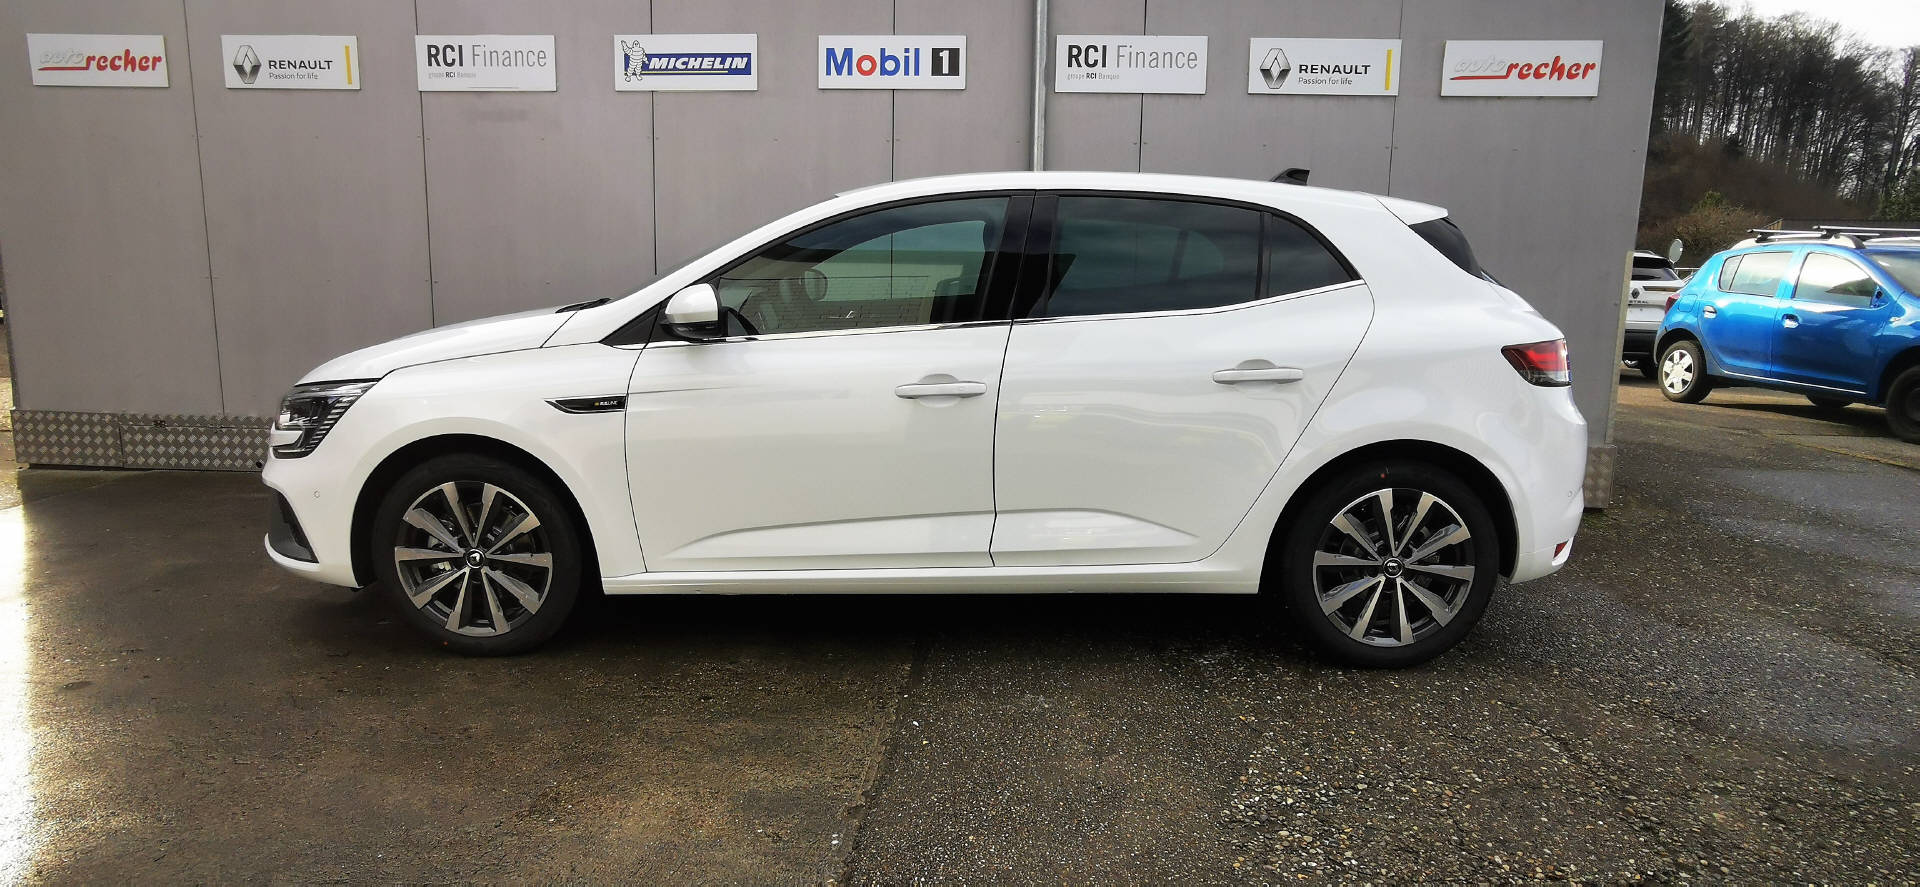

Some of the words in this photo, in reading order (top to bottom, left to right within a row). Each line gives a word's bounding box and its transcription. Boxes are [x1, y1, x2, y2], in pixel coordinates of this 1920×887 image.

[427, 44, 464, 67] RCI
[472, 44, 547, 67] Finance
[1067, 44, 1107, 68] RCI
[1116, 45, 1198, 69] Finance
[268, 60, 333, 70] RENAULT
[648, 57, 748, 69] MICHELIN
[826, 48, 920, 76] Mobil
[939, 50, 950, 74] 1
[1298, 64, 1371, 75] RENAULT
[1298, 77, 1327, 85] Passion
[1328, 77, 1340, 85] for
[1340, 77, 1353, 85] life
